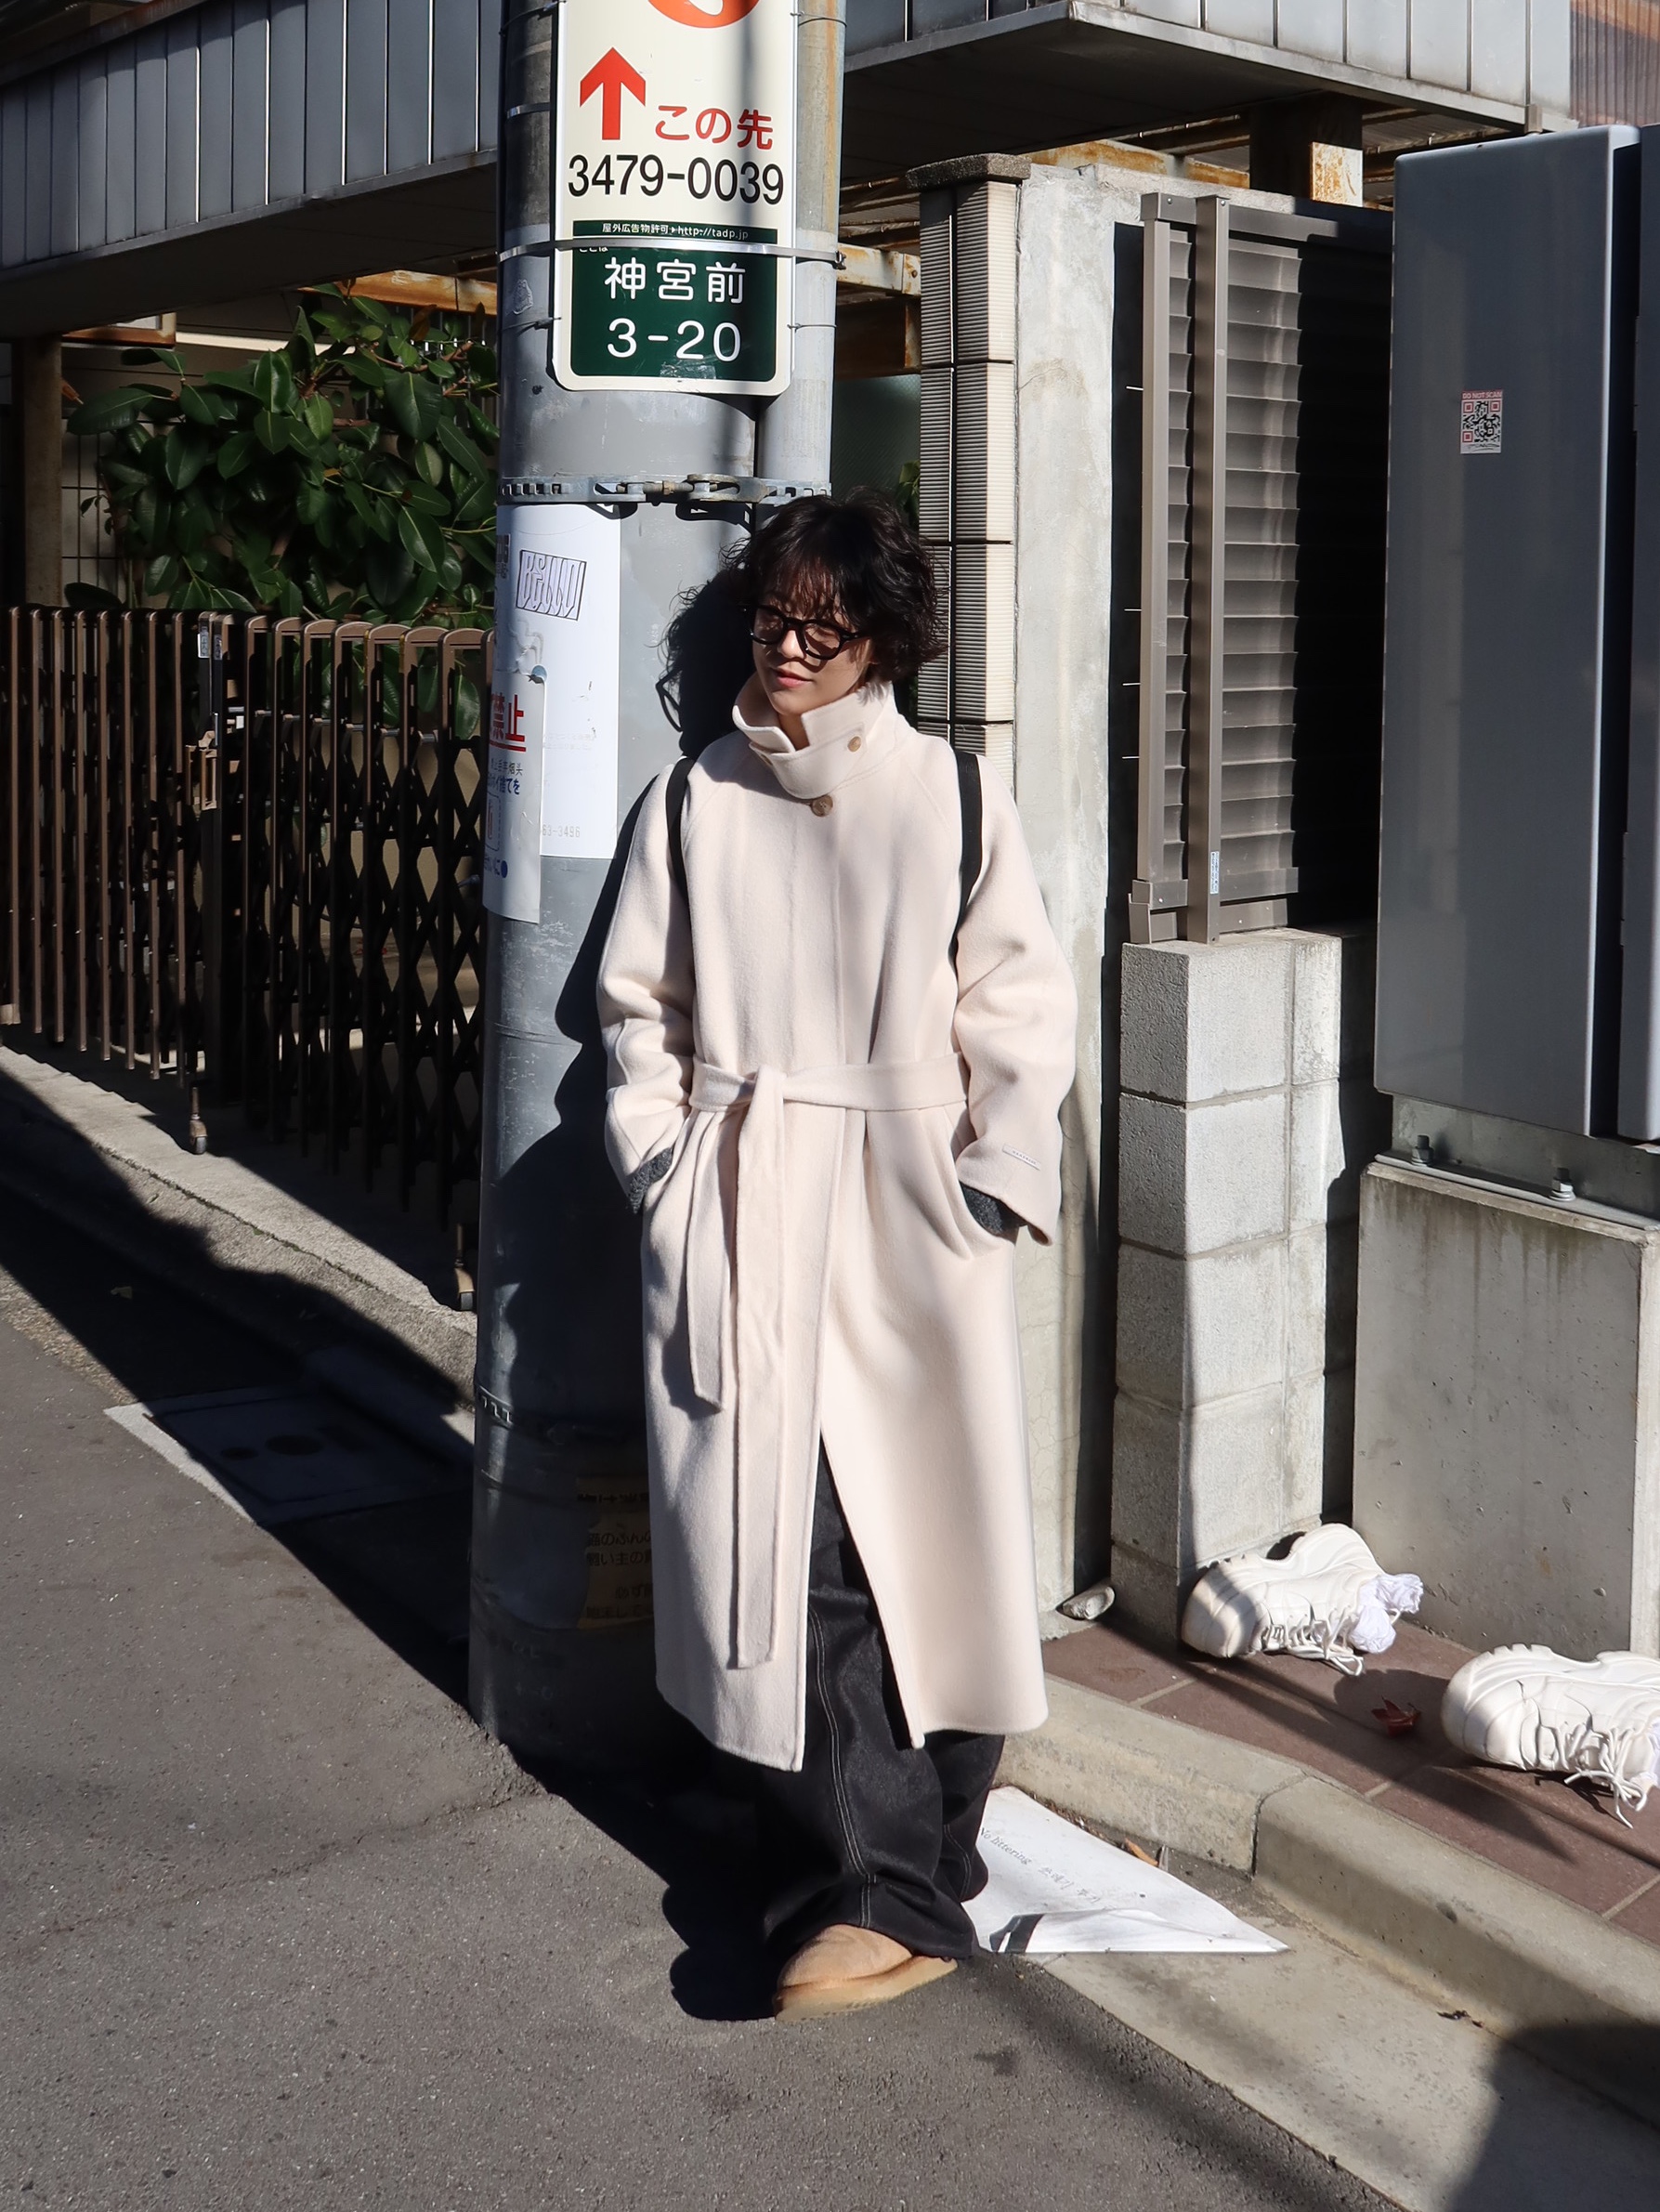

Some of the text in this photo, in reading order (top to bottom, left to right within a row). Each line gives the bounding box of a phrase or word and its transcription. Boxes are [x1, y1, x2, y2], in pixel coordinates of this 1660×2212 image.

[655, 105, 773, 150] この先
[568, 154, 783, 205] 3479-0039
[604, 256, 746, 304] 神宮前
[607, 318, 741, 362] 3-20
[586, 1549, 651, 1566] 飼い主の
[990, 1836, 1032, 1865] littering
